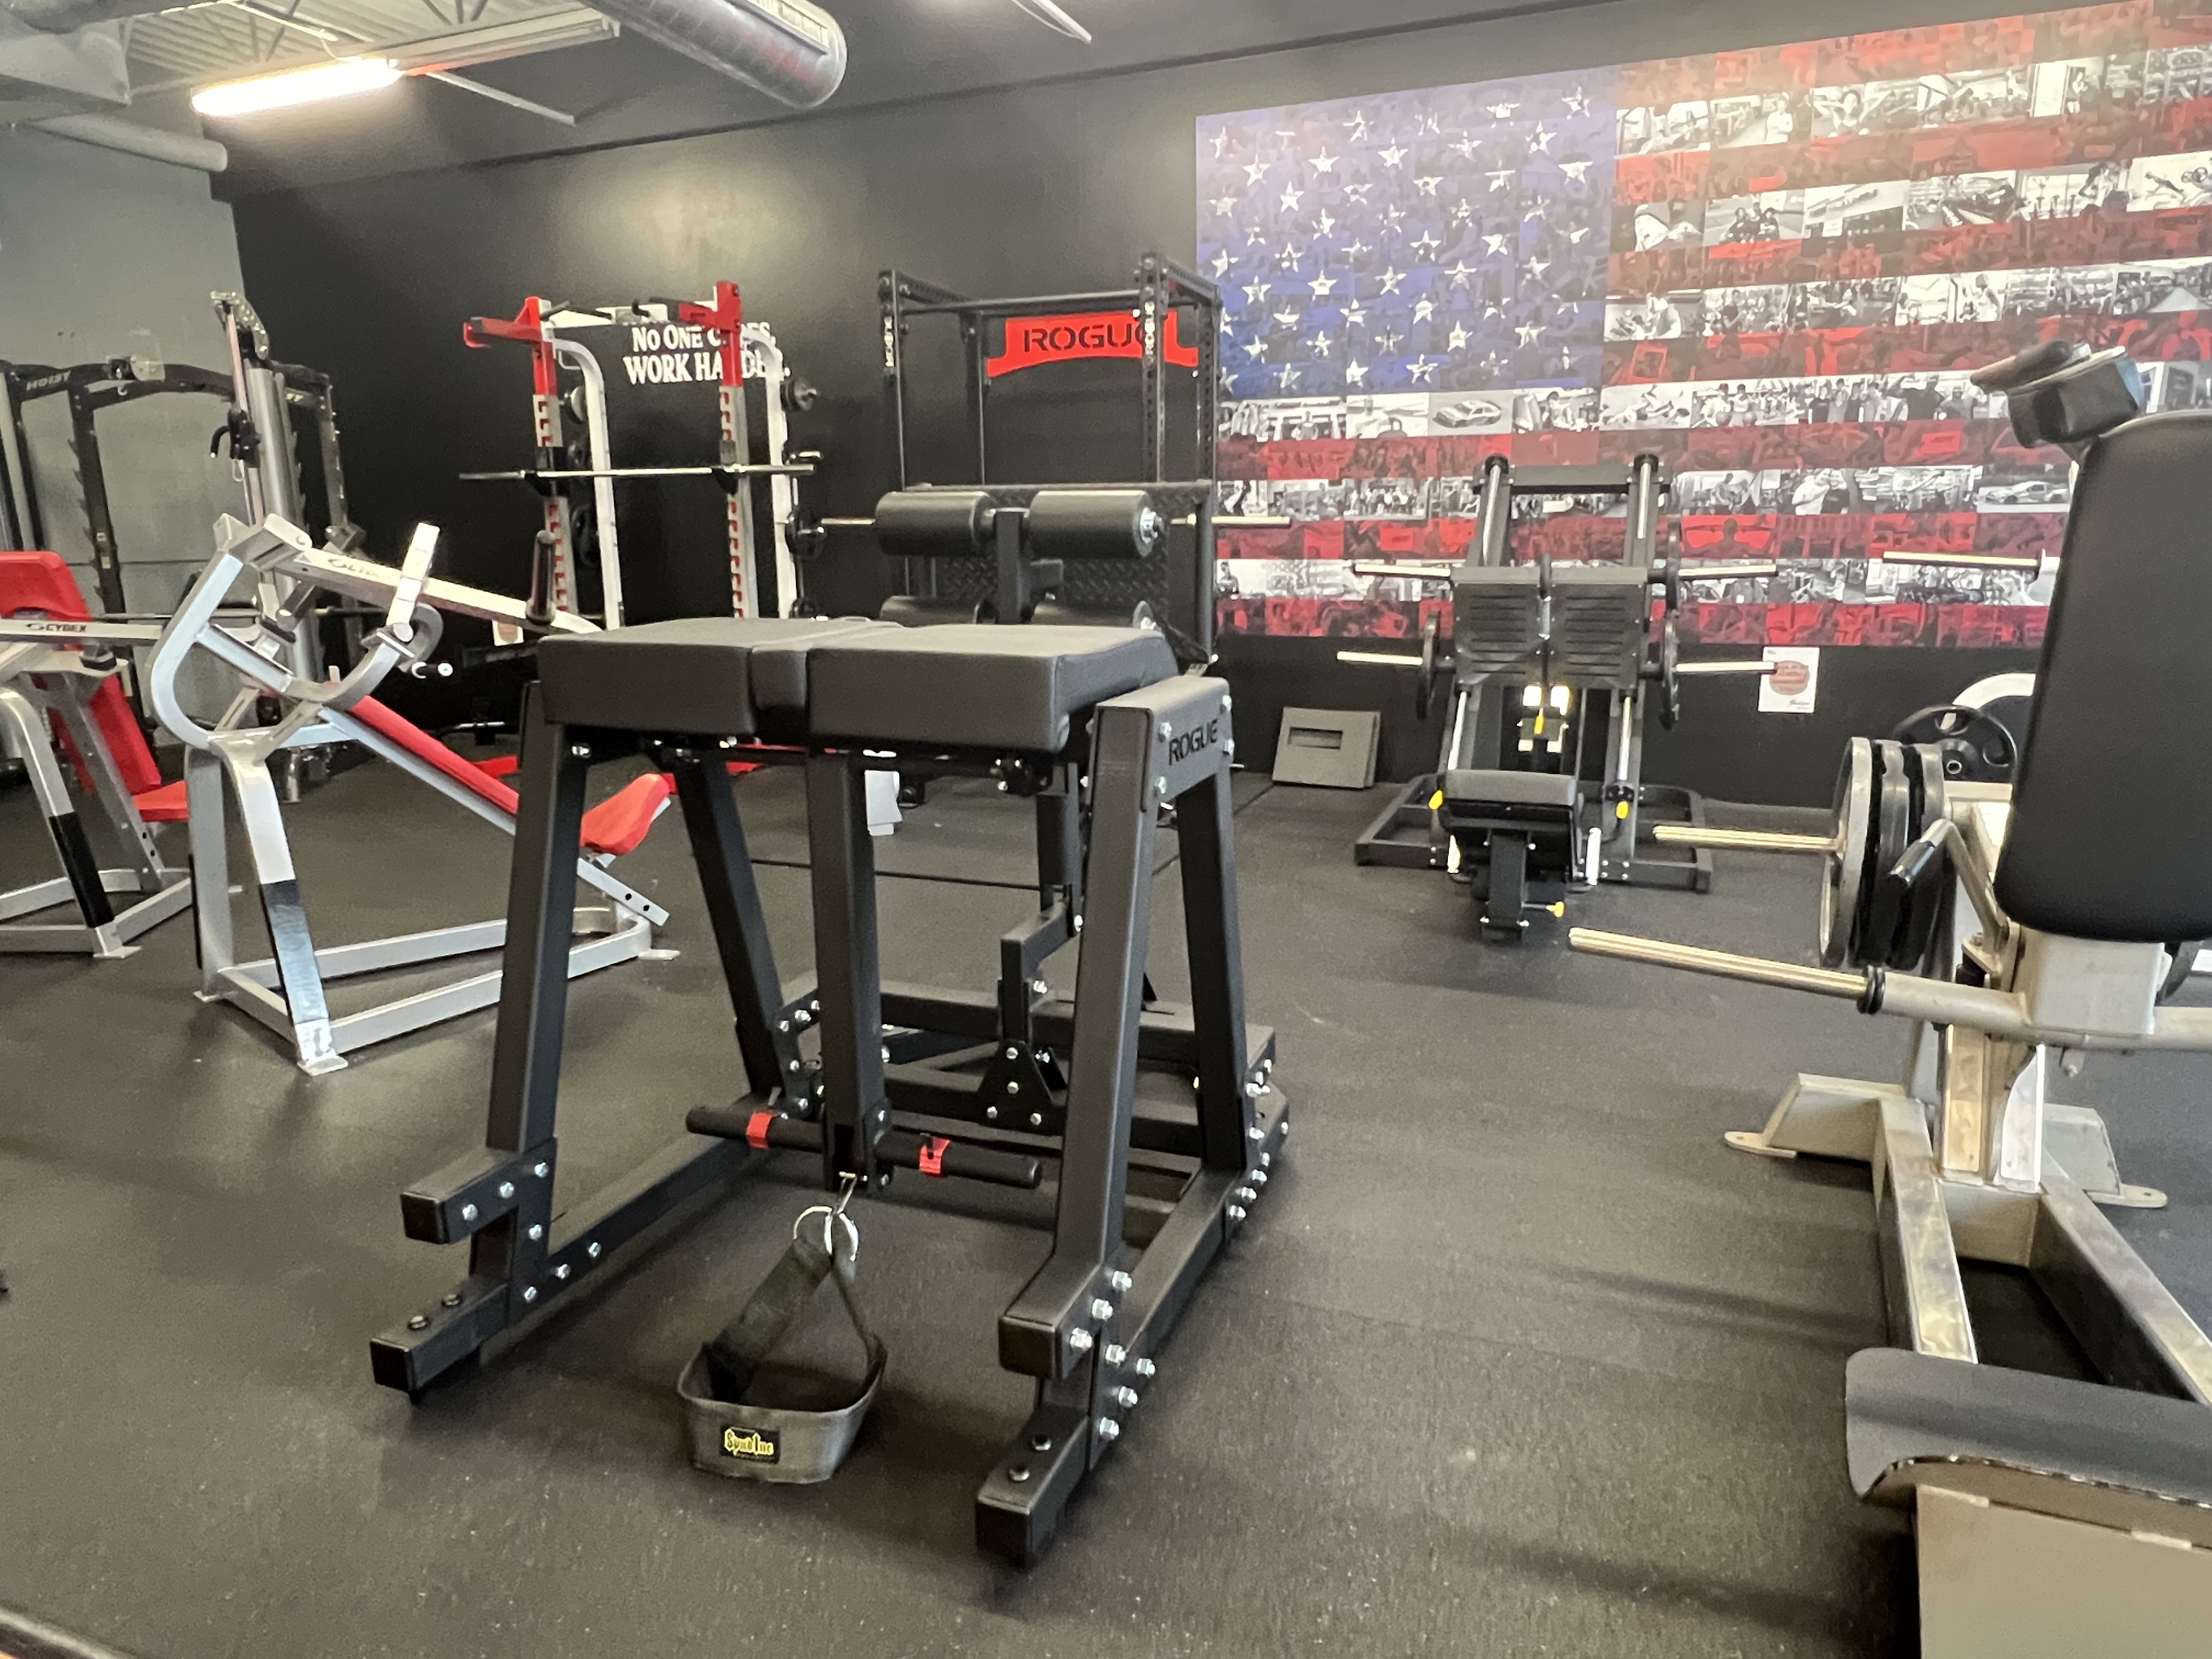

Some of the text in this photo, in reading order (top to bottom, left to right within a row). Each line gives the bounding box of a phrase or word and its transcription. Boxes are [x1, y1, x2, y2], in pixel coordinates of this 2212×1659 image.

[663, 324, 703, 350] ONE
[707, 322, 776, 347] CS.
[1024, 323, 1143, 352] ROGU
[1144, 301, 1155, 355] ROU
[623, 349, 791, 385] WORK HADE.
[1169, 719, 1217, 766] ROGUE
